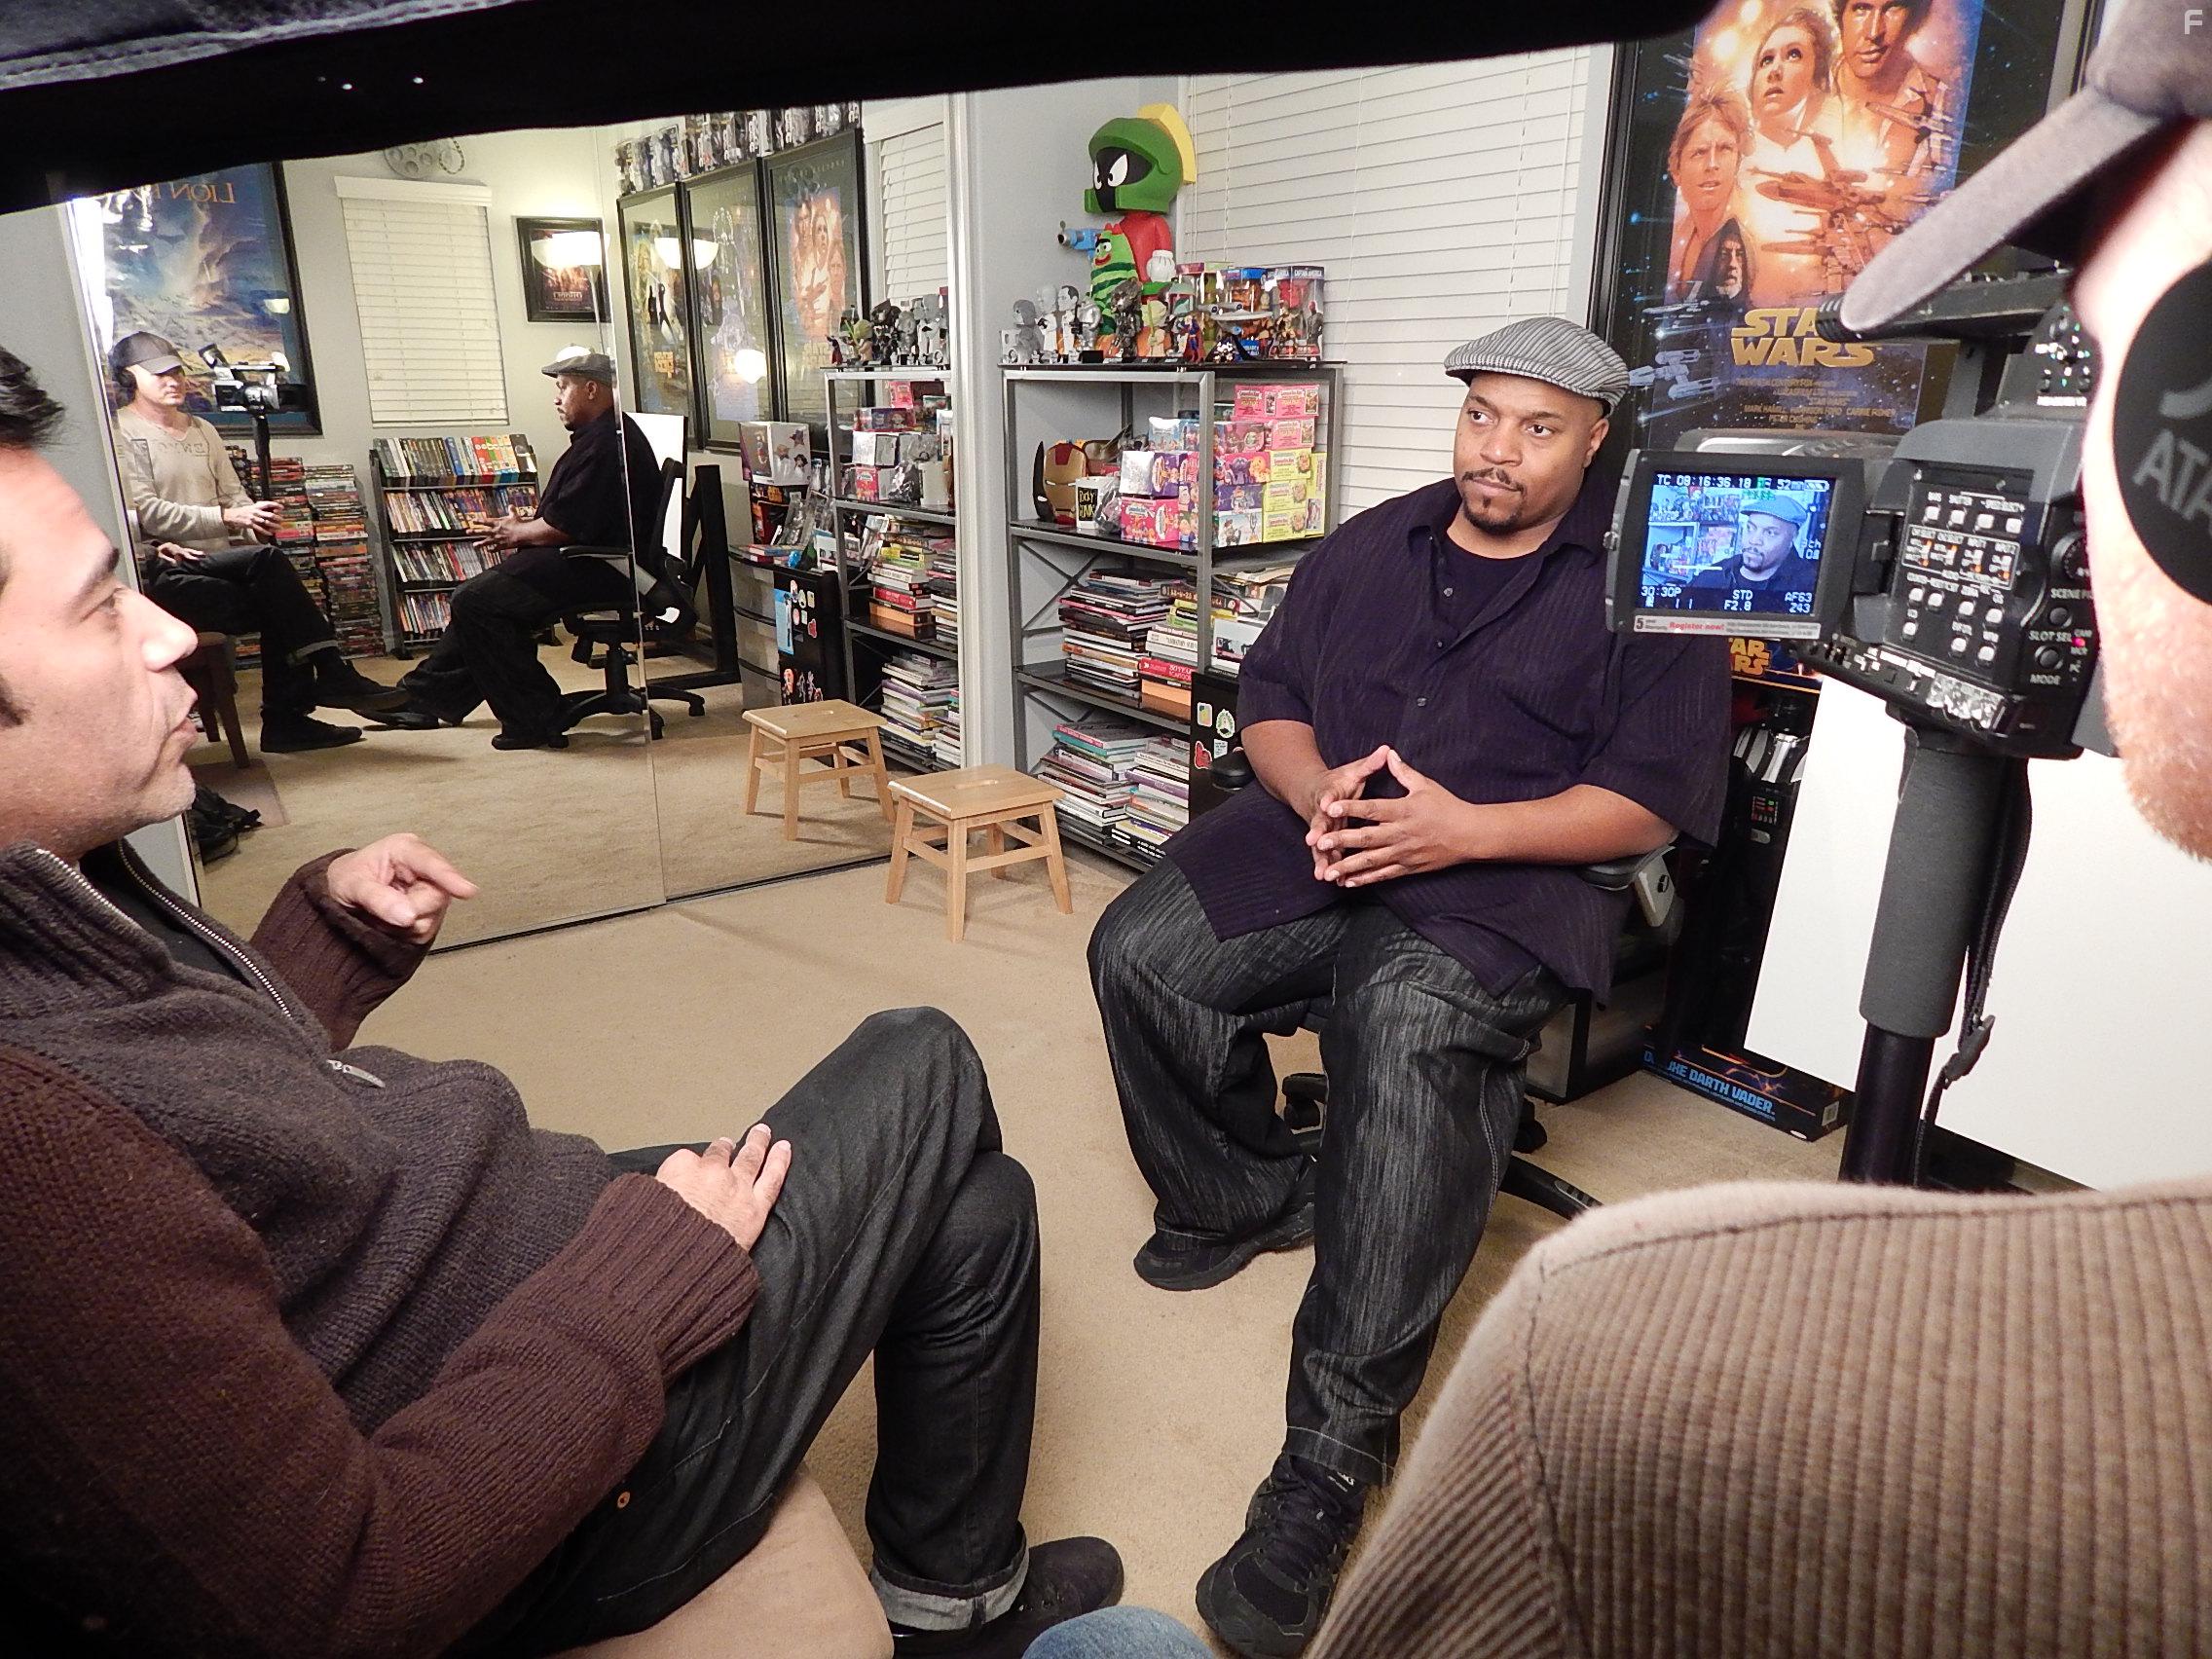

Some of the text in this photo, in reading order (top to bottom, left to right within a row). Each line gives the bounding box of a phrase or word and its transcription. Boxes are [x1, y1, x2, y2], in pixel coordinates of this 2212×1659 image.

[1731, 308, 1819, 338] STA
[1731, 338, 1874, 368] WARS
[1657, 474, 1672, 485] TC
[1732, 589, 1753, 601] STD
[2050, 588, 2081, 600] SCENE
[1636, 618, 1644, 630] 5
[1669, 621, 1703, 631] Register
[2029, 630, 2072, 643] SLOT SEL
[2030, 674, 2061, 685] MODE
[1689, 1068, 1730, 1095] DARTH
